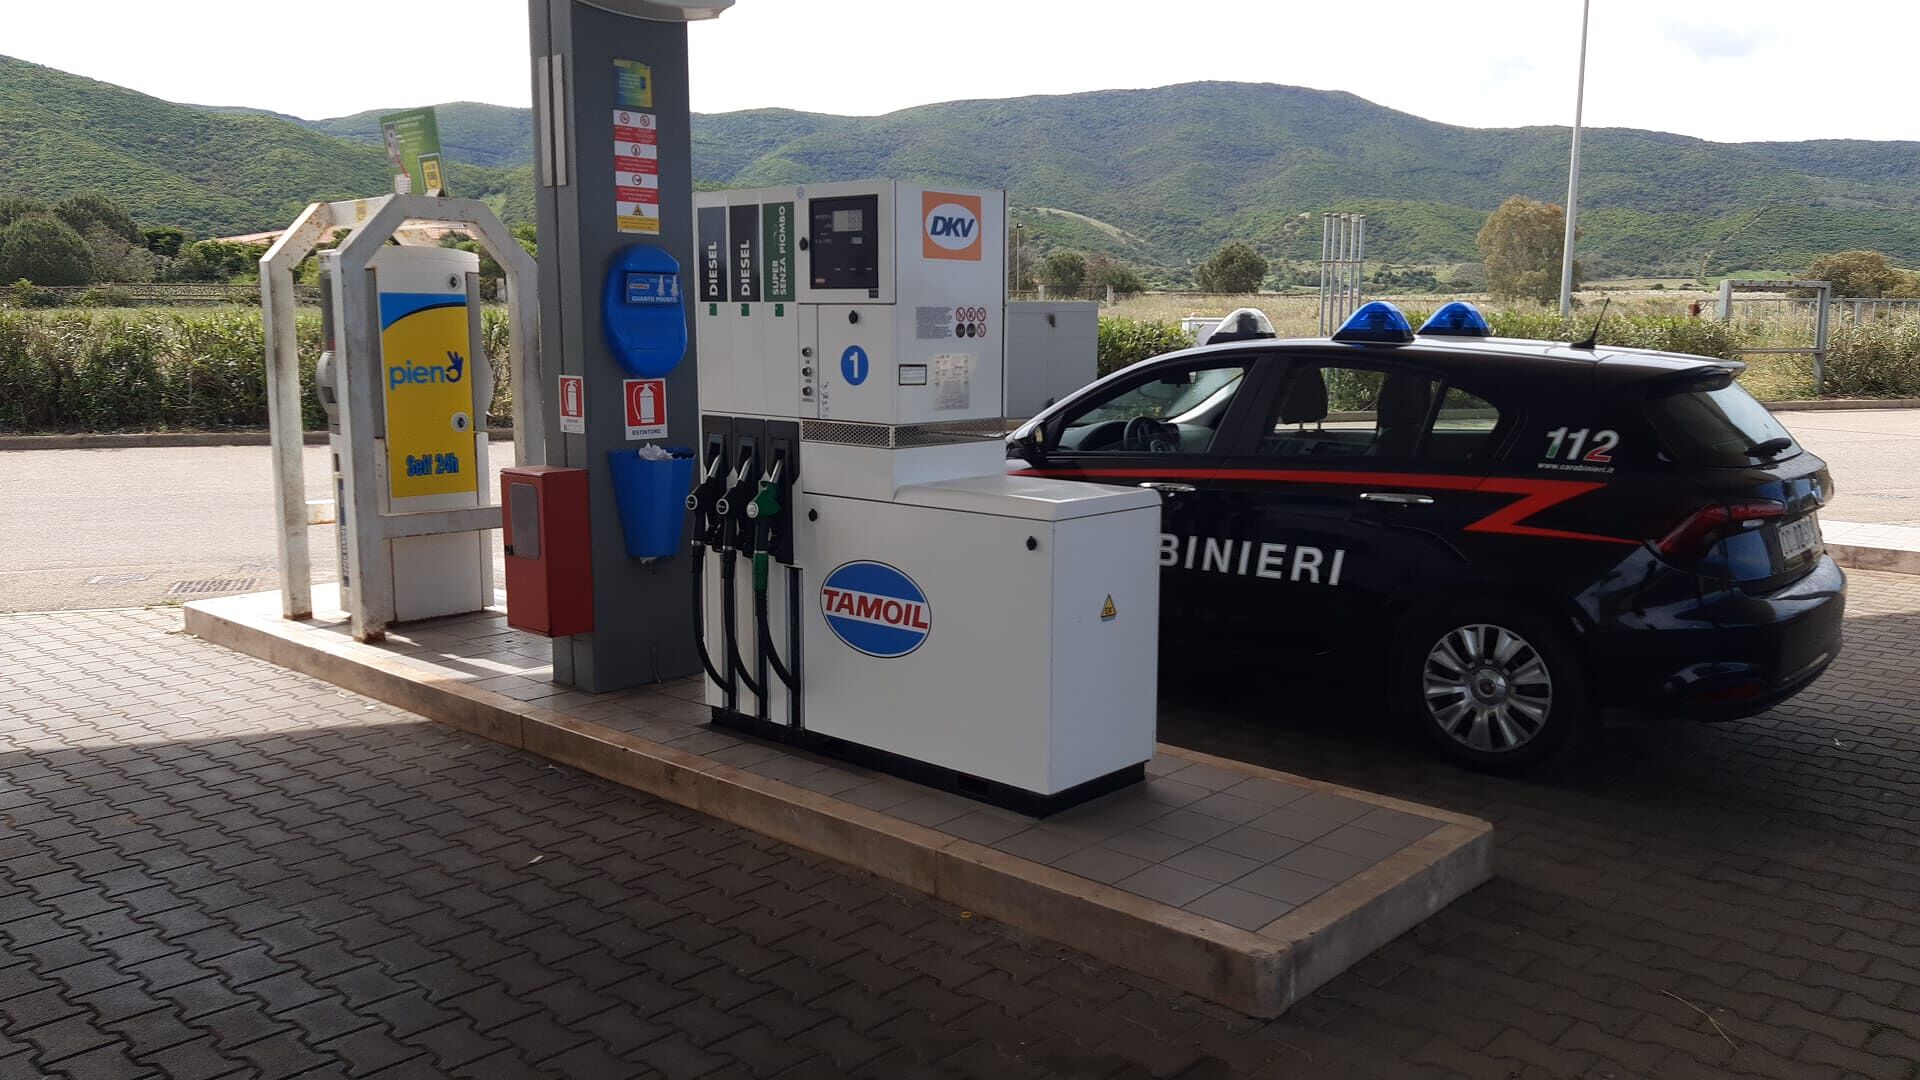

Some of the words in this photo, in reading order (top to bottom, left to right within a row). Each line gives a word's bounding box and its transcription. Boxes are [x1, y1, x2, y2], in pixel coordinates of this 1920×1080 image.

[778, 205, 786, 254] PIOMBO
[930, 215, 975, 238] DKV
[708, 241, 718, 296] DIESEL
[740, 239, 751, 296] DIESEL
[772, 260, 780, 296] SUPER
[779, 257, 787, 296] SENZA
[849, 351, 859, 379] 1
[1545, 426, 1620, 463] 112
[406, 453, 432, 477] Self
[435, 452, 459, 475] 24h
[823, 588, 929, 630] TAMOIL
